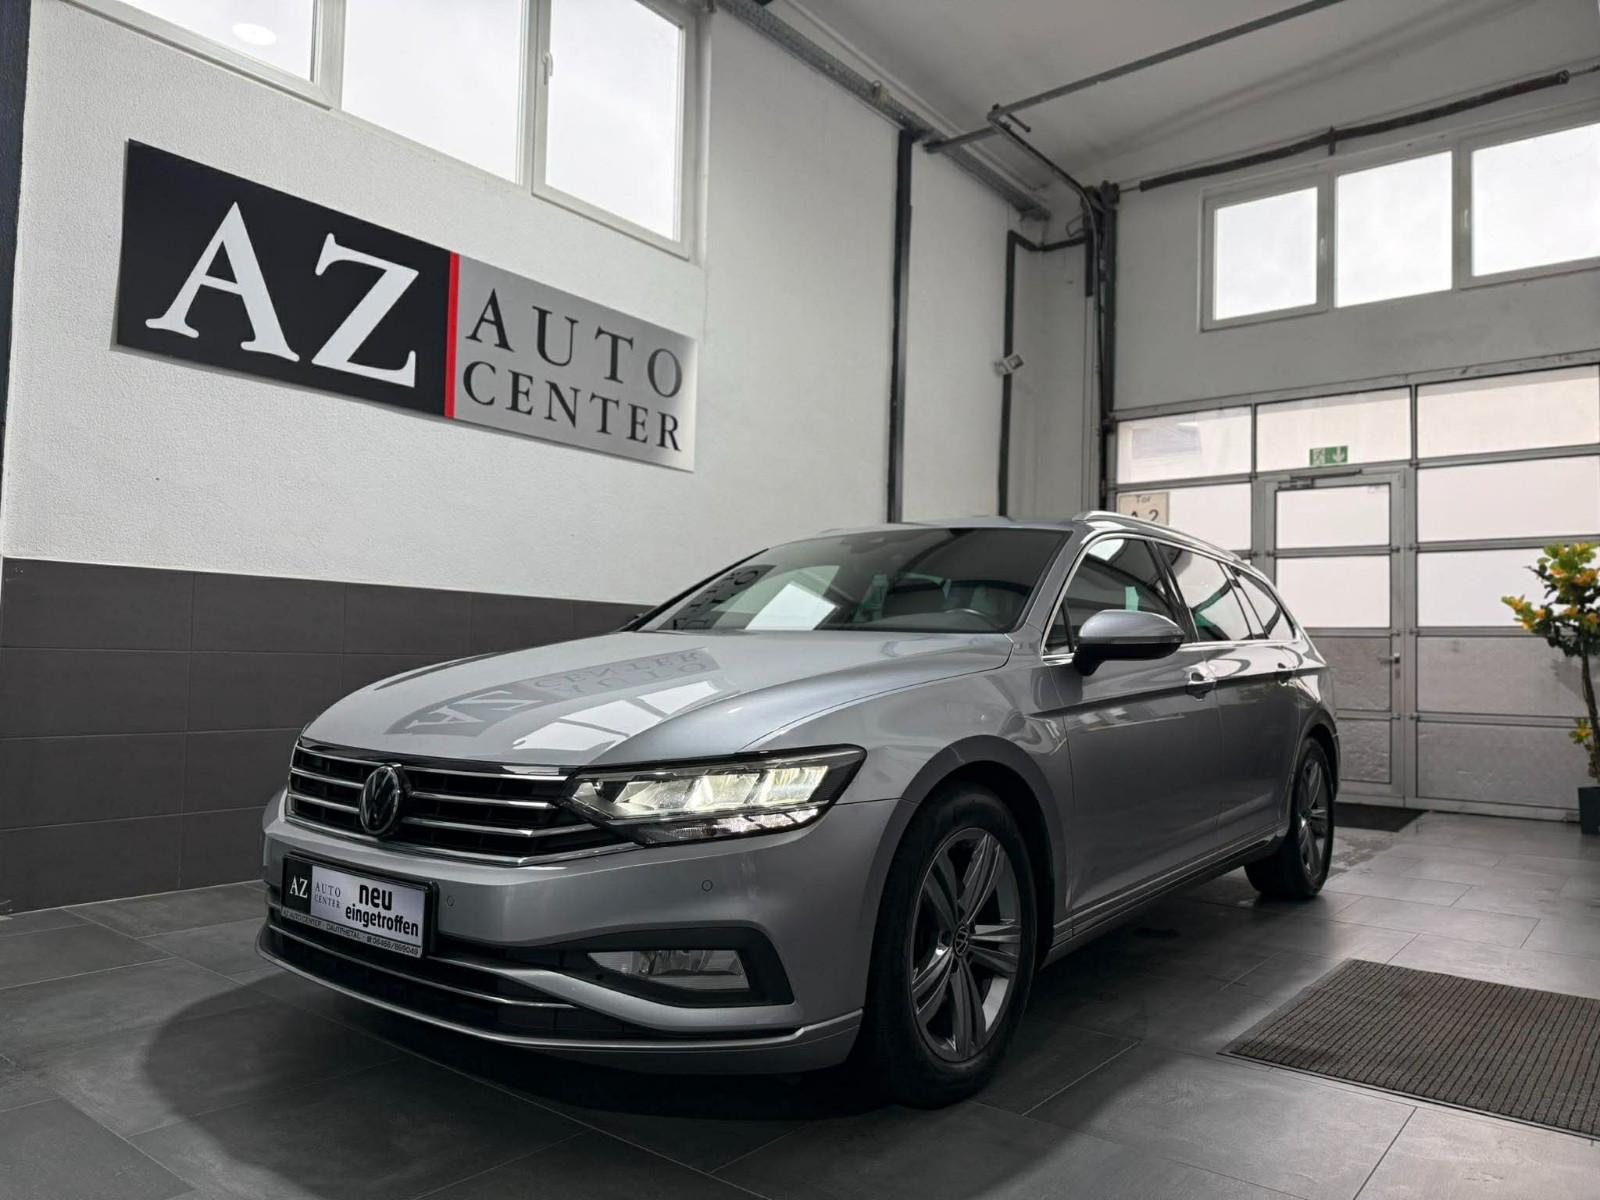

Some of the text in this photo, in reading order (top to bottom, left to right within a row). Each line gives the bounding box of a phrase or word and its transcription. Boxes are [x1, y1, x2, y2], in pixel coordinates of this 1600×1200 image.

[145, 201, 419, 388] AZ
[465, 288, 683, 399] AUTO
[463, 361, 682, 452] CENTER
[289, 875, 308, 899] AZ
[314, 881, 341, 898] AUTO
[314, 894, 341, 909] CENTER
[359, 884, 393, 911] neu
[345, 904, 419, 937] eingetroffen
